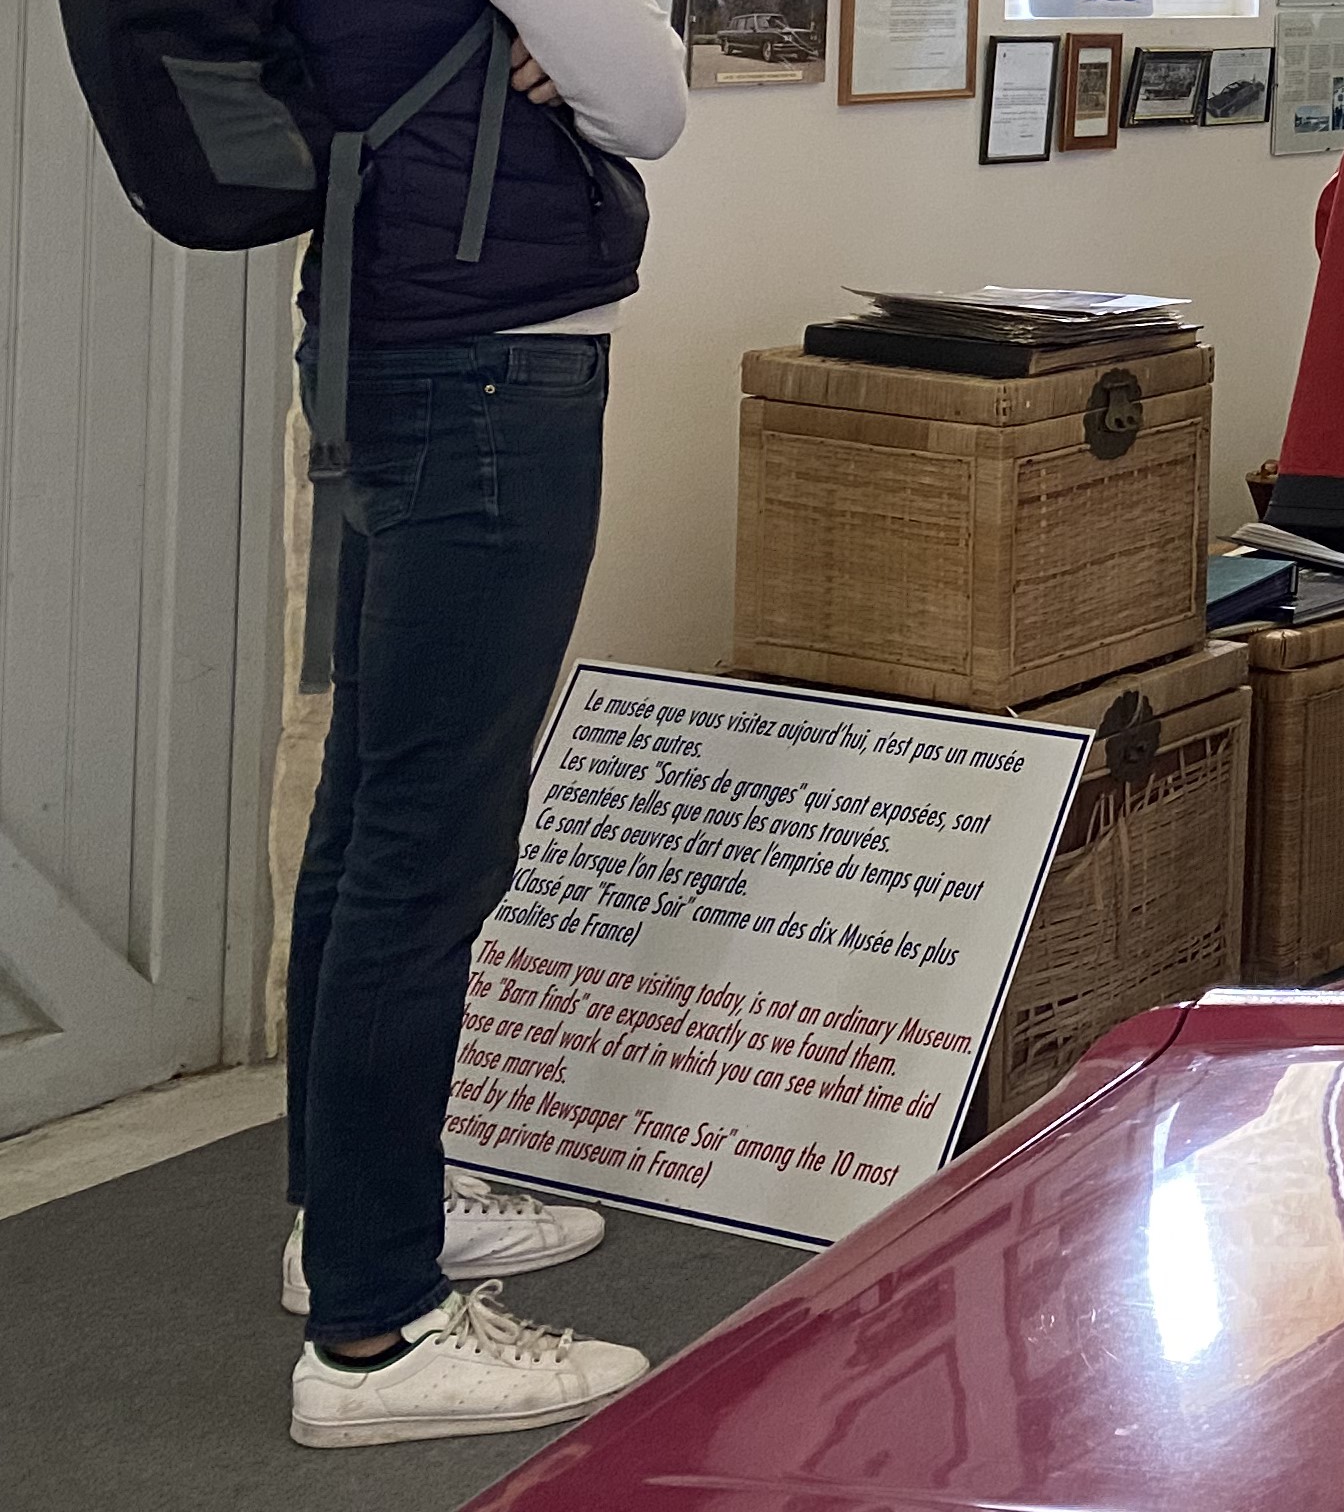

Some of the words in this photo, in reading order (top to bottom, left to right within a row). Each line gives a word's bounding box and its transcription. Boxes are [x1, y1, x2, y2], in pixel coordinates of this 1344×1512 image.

[572, 724, 627, 746] comme
[627, 724, 649, 749] les
[652, 734, 703, 758] autres.
[584, 688, 603, 711] Le
[604, 697, 654, 719] musée
[656, 704, 686, 726] que
[689, 709, 725, 729] vous
[727, 711, 777, 736] visitez
[778, 719, 870, 755] aujourd'hui,
[873, 732, 914, 757] n'est
[909, 743, 944, 763] pas
[945, 747, 968, 765] un
[969, 750, 1025, 772] musée
[543, 780, 629, 810] présentées
[628, 788, 668, 817] telles
[671, 802, 702, 824] que
[703, 809, 744, 829] nous
[742, 805, 768, 832] les
[769, 818, 816, 839] avons
[818, 823, 891, 853] trouvées.
[559, 747, 587, 771] Les
[588, 754, 649, 781] voitures
[655, 759, 710, 790] "Sorties
[711, 768, 733, 794] de
[730, 780, 809, 807] granges"
[804, 788, 836, 815] qui
[832, 795, 870, 815] sont
[870, 802, 946, 830] exposées,
[952, 811, 992, 835] sont
[520, 842, 540, 859] se
[541, 838, 568, 865] lire
[568, 842, 627, 878] lorsque
[627, 852, 658, 880] l'on
[657, 857, 686, 885] les
[682, 869, 747, 897] regarde.
[536, 807, 555, 830] Ce
[555, 816, 592, 835] sont
[591, 814, 620, 839] des
[620, 826, 682, 851] oeuvres
[683, 829, 723, 857] d'art
[722, 844, 761, 864] avec
[761, 841, 834, 876] l'emprise
[836, 854, 857, 880] du
[860, 862, 909, 893] temps
[913, 872, 946, 897] qui
[939, 880, 985, 902] peut
[494, 899, 559, 932] insolites
[558, 907, 580, 934] de
[581, 913, 643, 948] France)
[558, 883, 592, 904] par
[597, 880, 651, 914] "France
[652, 891, 695, 918] Soir"
[692, 904, 751, 930] comme
[752, 915, 776, 933] un
[777, 911, 808, 939] des
[808, 916, 838, 945] dix
[838, 924, 894, 955] Musée
[895, 931, 922, 961] les
[918, 937, 960, 968] plus
[476, 939, 505, 966] The
[505, 946, 573, 979] Museum
[569, 965, 605, 986] you
[606, 970, 635, 990] are
[637, 972, 695, 1007] visiting
[695, 982, 746, 1016] today,
[749, 991, 766, 1014] is
[766, 1000, 798, 1020] not
[799, 1006, 821, 1025] an
[822, 1004, 898, 1045] ordinary
[897, 1017, 973, 1055] Museum.
